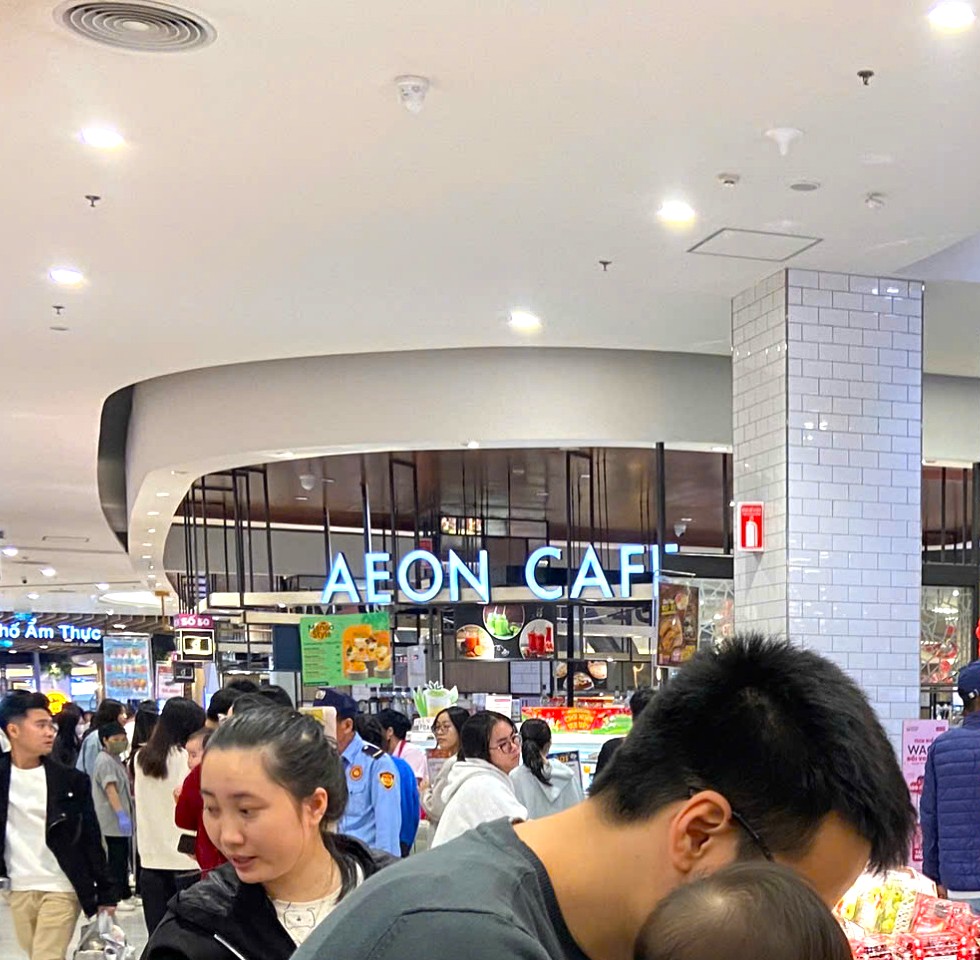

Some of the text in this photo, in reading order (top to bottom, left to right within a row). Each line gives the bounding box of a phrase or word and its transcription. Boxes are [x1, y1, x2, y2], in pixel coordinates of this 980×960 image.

[321, 549, 491, 604] AEON
[58, 624, 102, 642] Thực
[908, 745, 928, 755] WA
